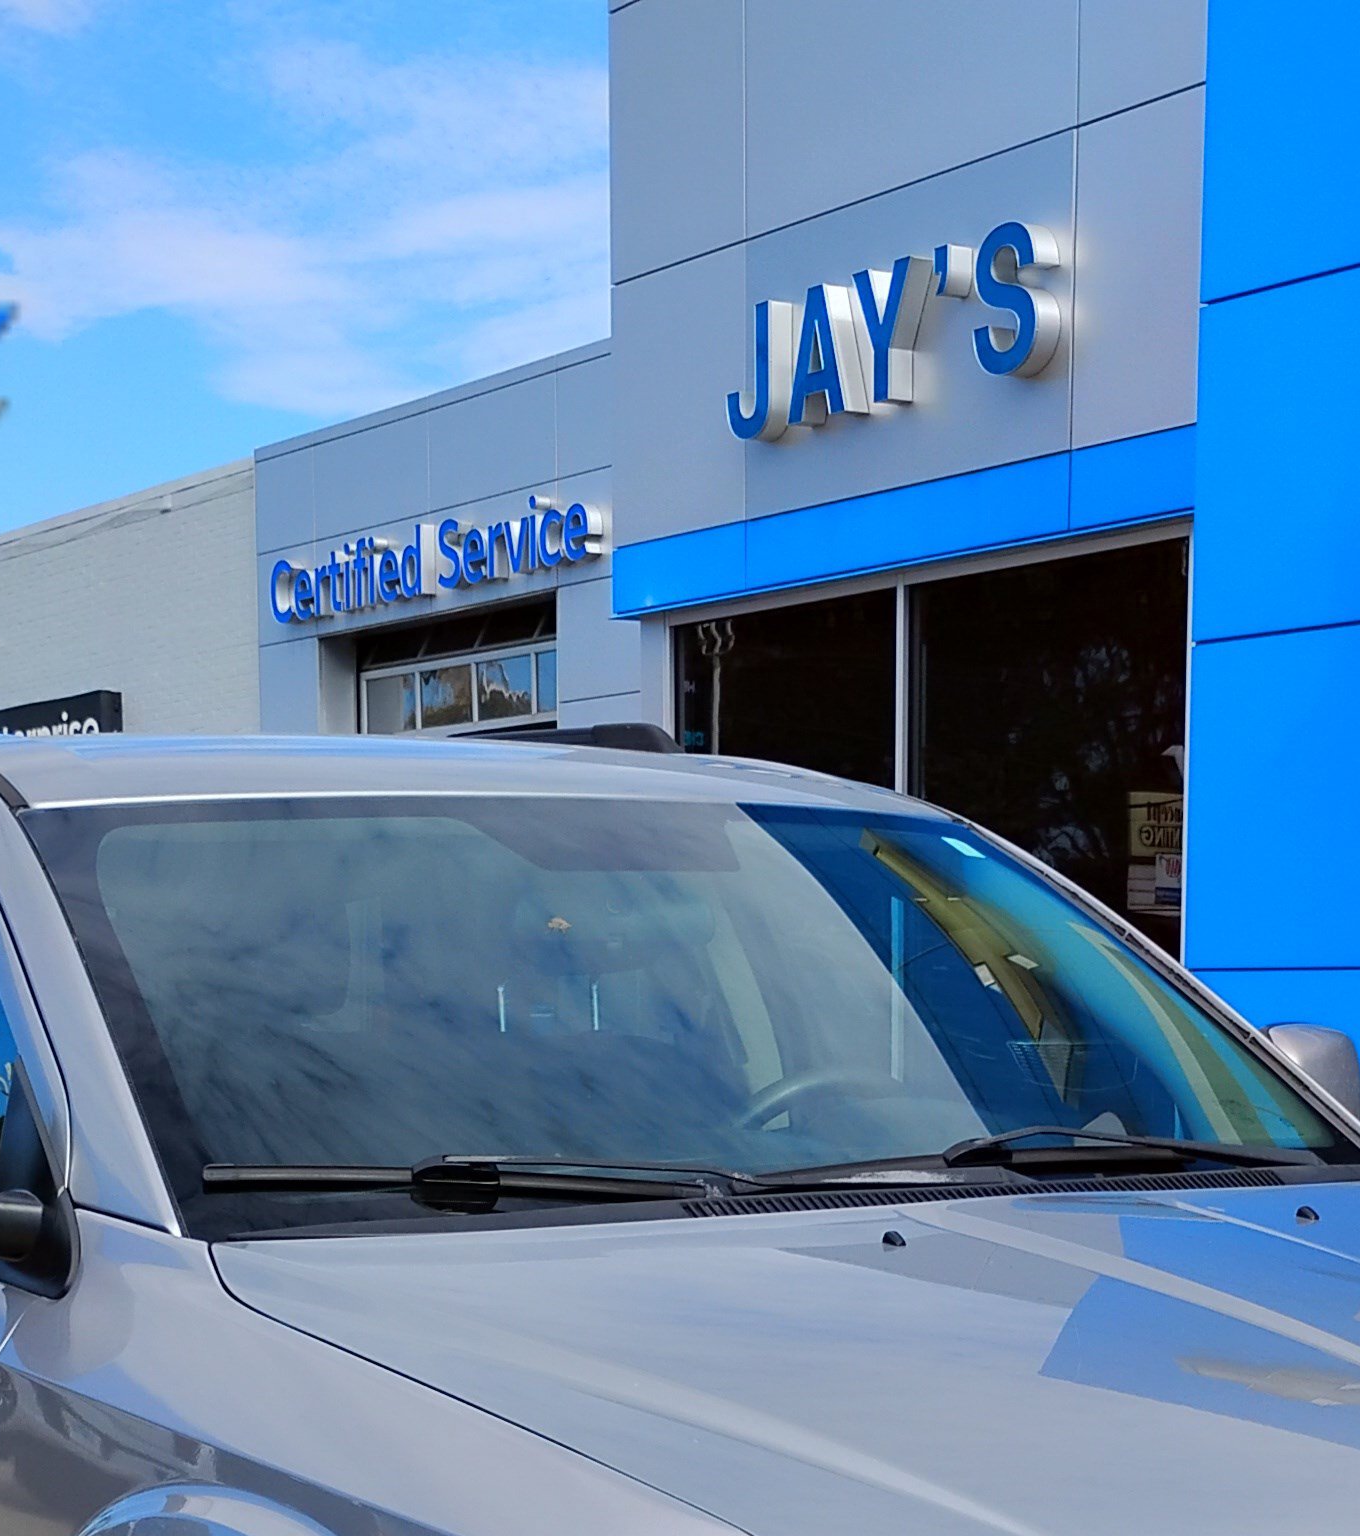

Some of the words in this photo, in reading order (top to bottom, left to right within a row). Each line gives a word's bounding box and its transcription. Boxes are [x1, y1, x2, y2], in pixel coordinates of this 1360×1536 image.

[725, 221, 1058, 441] JAY'S
[271, 528, 430, 624] Certified
[439, 496, 596, 590] Service
